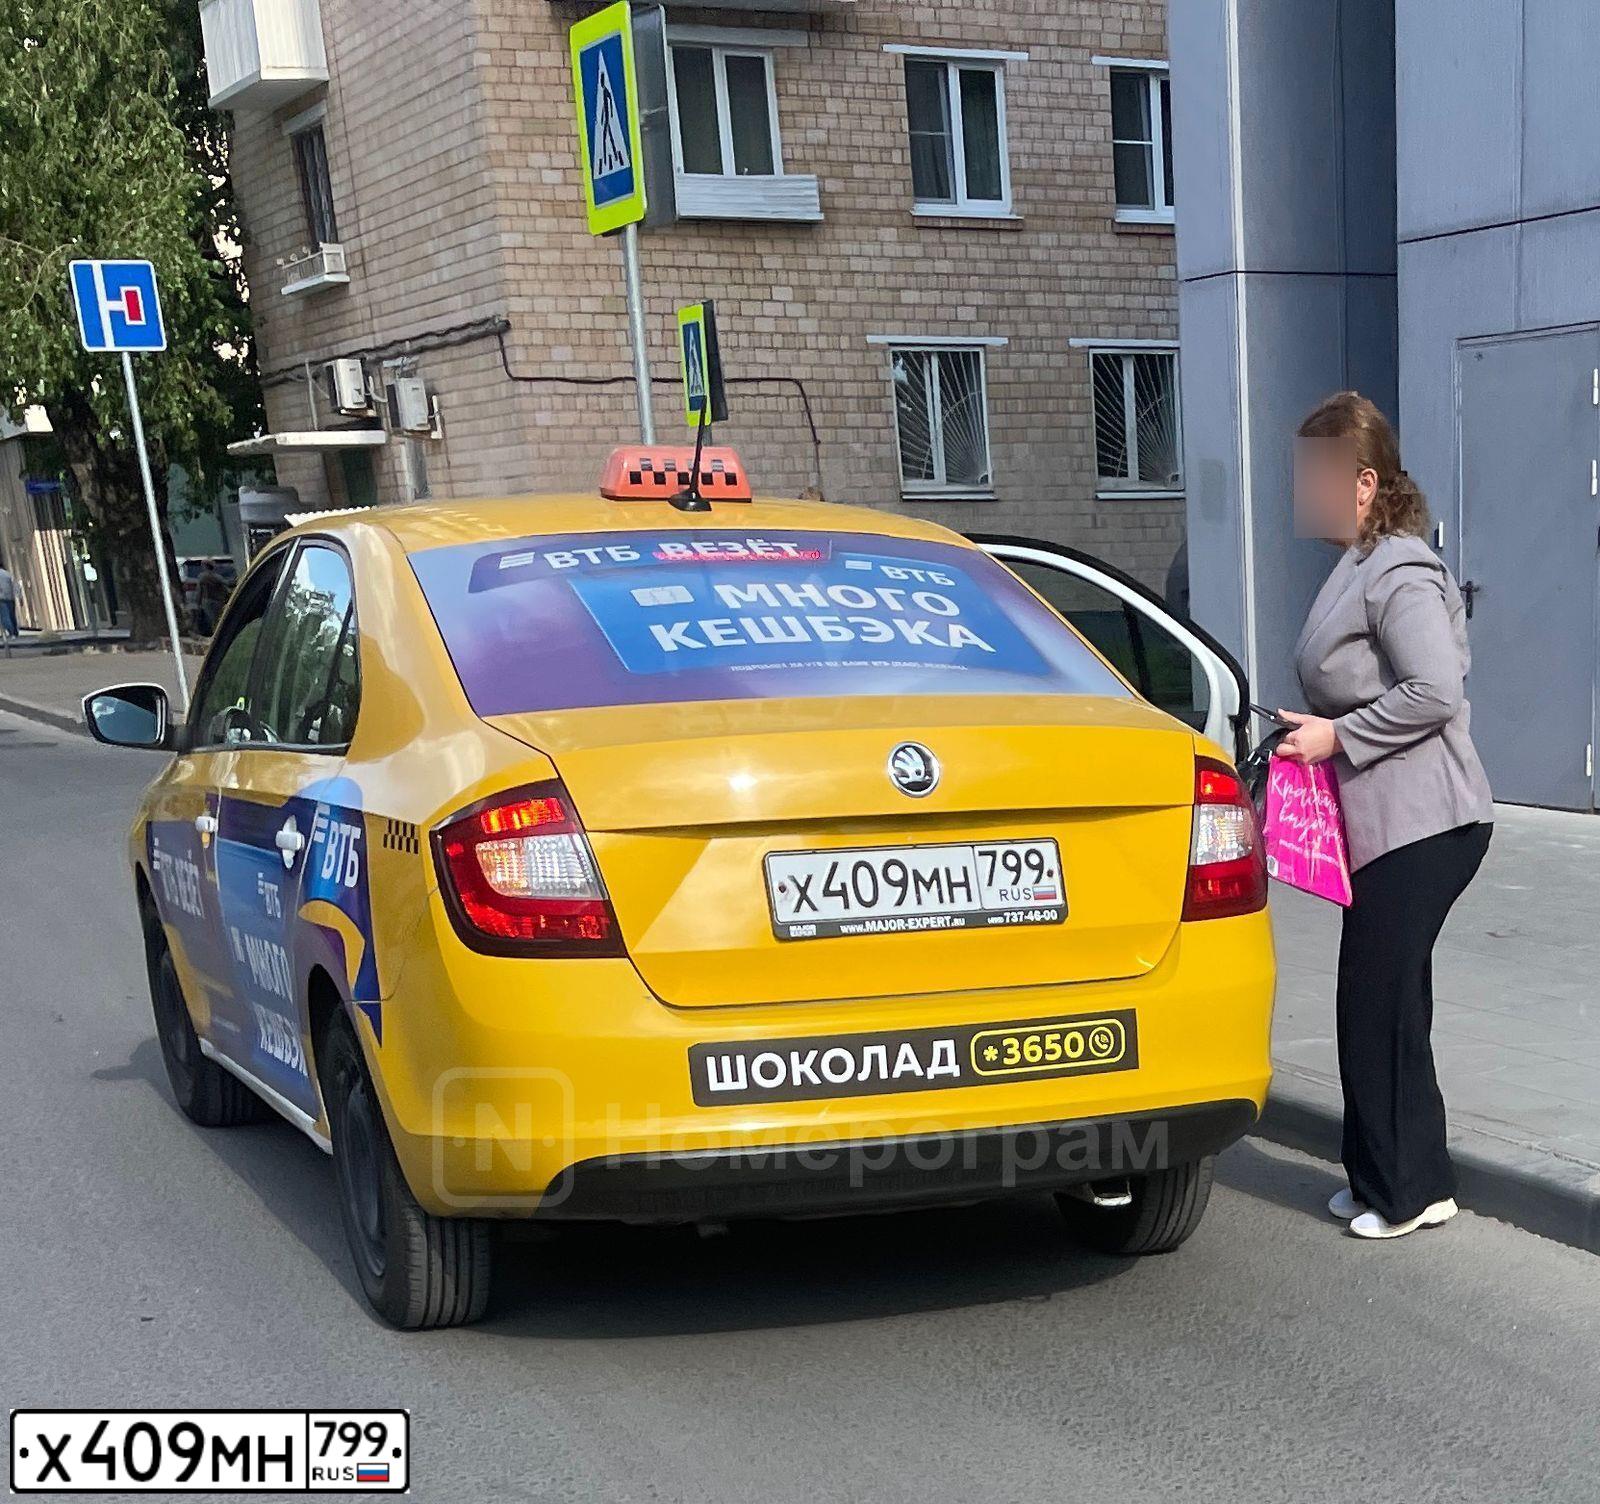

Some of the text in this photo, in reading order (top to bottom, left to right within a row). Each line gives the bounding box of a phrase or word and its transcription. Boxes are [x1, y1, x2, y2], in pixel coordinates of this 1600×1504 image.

[544, 539, 799, 569] ВТБ ВЕЗЁТ
[880, 565, 955, 586] ВТБ
[714, 583, 961, 616] МНОГО
[649, 615, 997, 653] КЕШБЭКА
[321, 820, 362, 888] ВТБ
[788, 848, 1045, 914] Х409МН 799
[999, 887, 1032, 902] RUS
[706, 1039, 960, 1092] ШОКОЛАД
